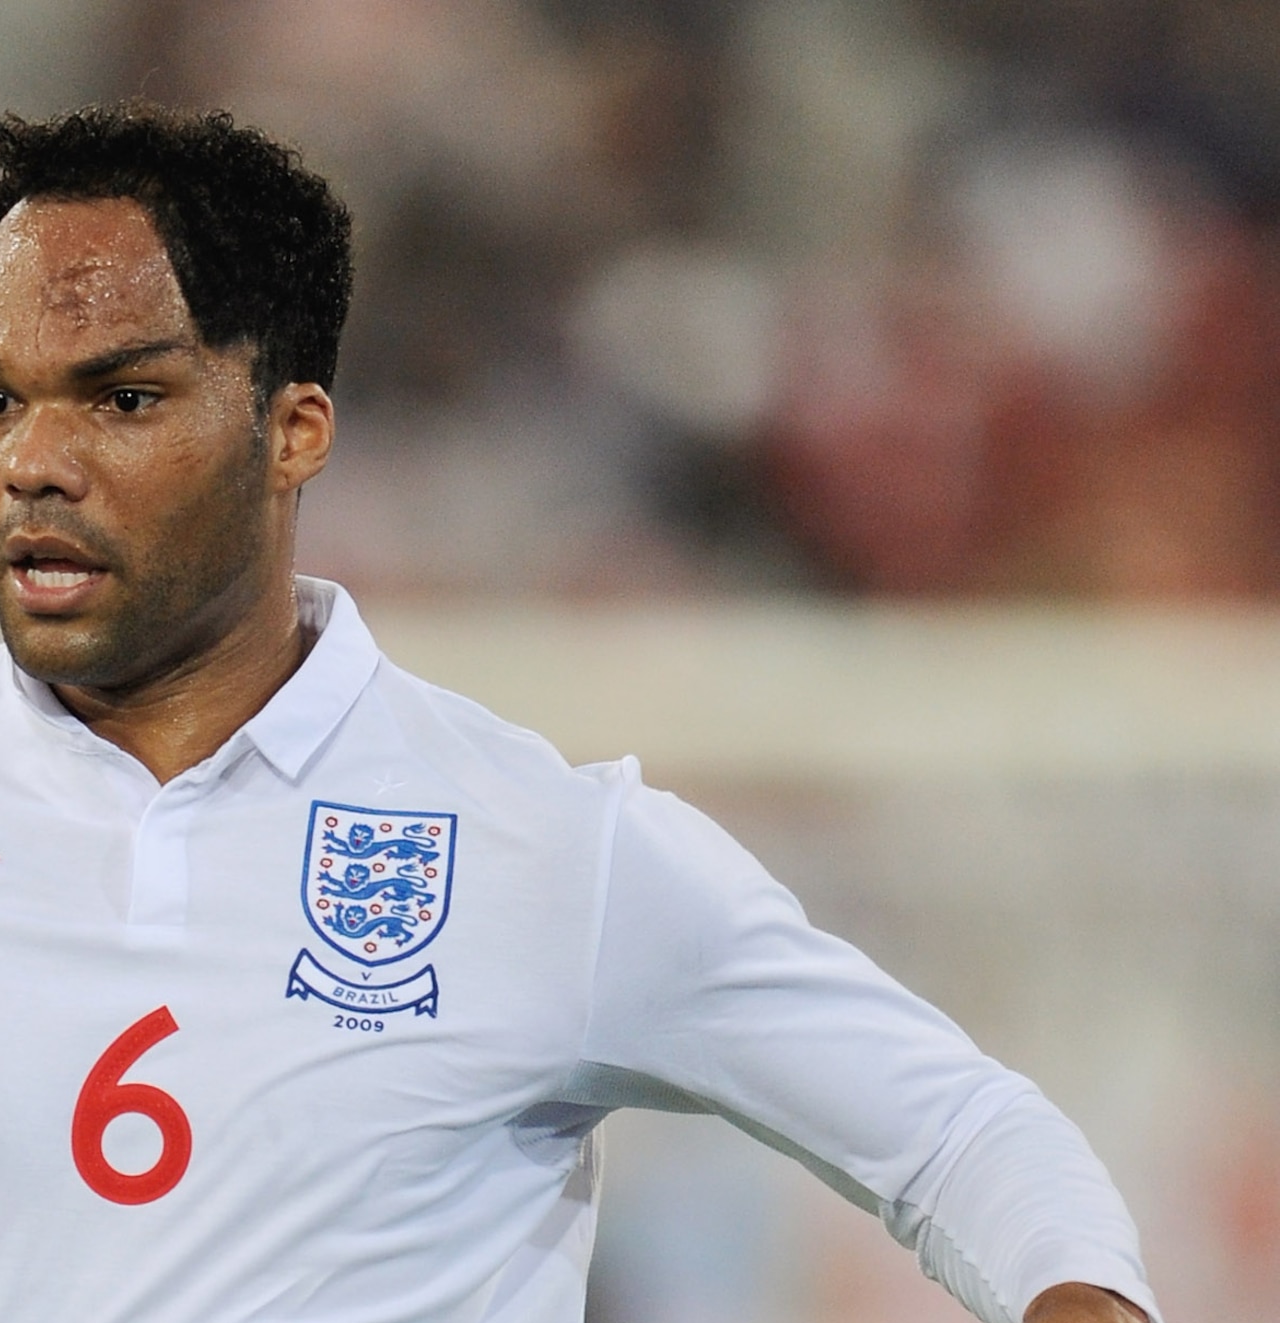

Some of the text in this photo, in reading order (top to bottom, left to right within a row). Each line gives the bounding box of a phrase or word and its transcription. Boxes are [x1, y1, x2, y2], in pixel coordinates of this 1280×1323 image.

[332, 986, 399, 1005] BRAZIL
[333, 1014, 385, 1033] 2009
[71, 1005, 193, 1206] 6
